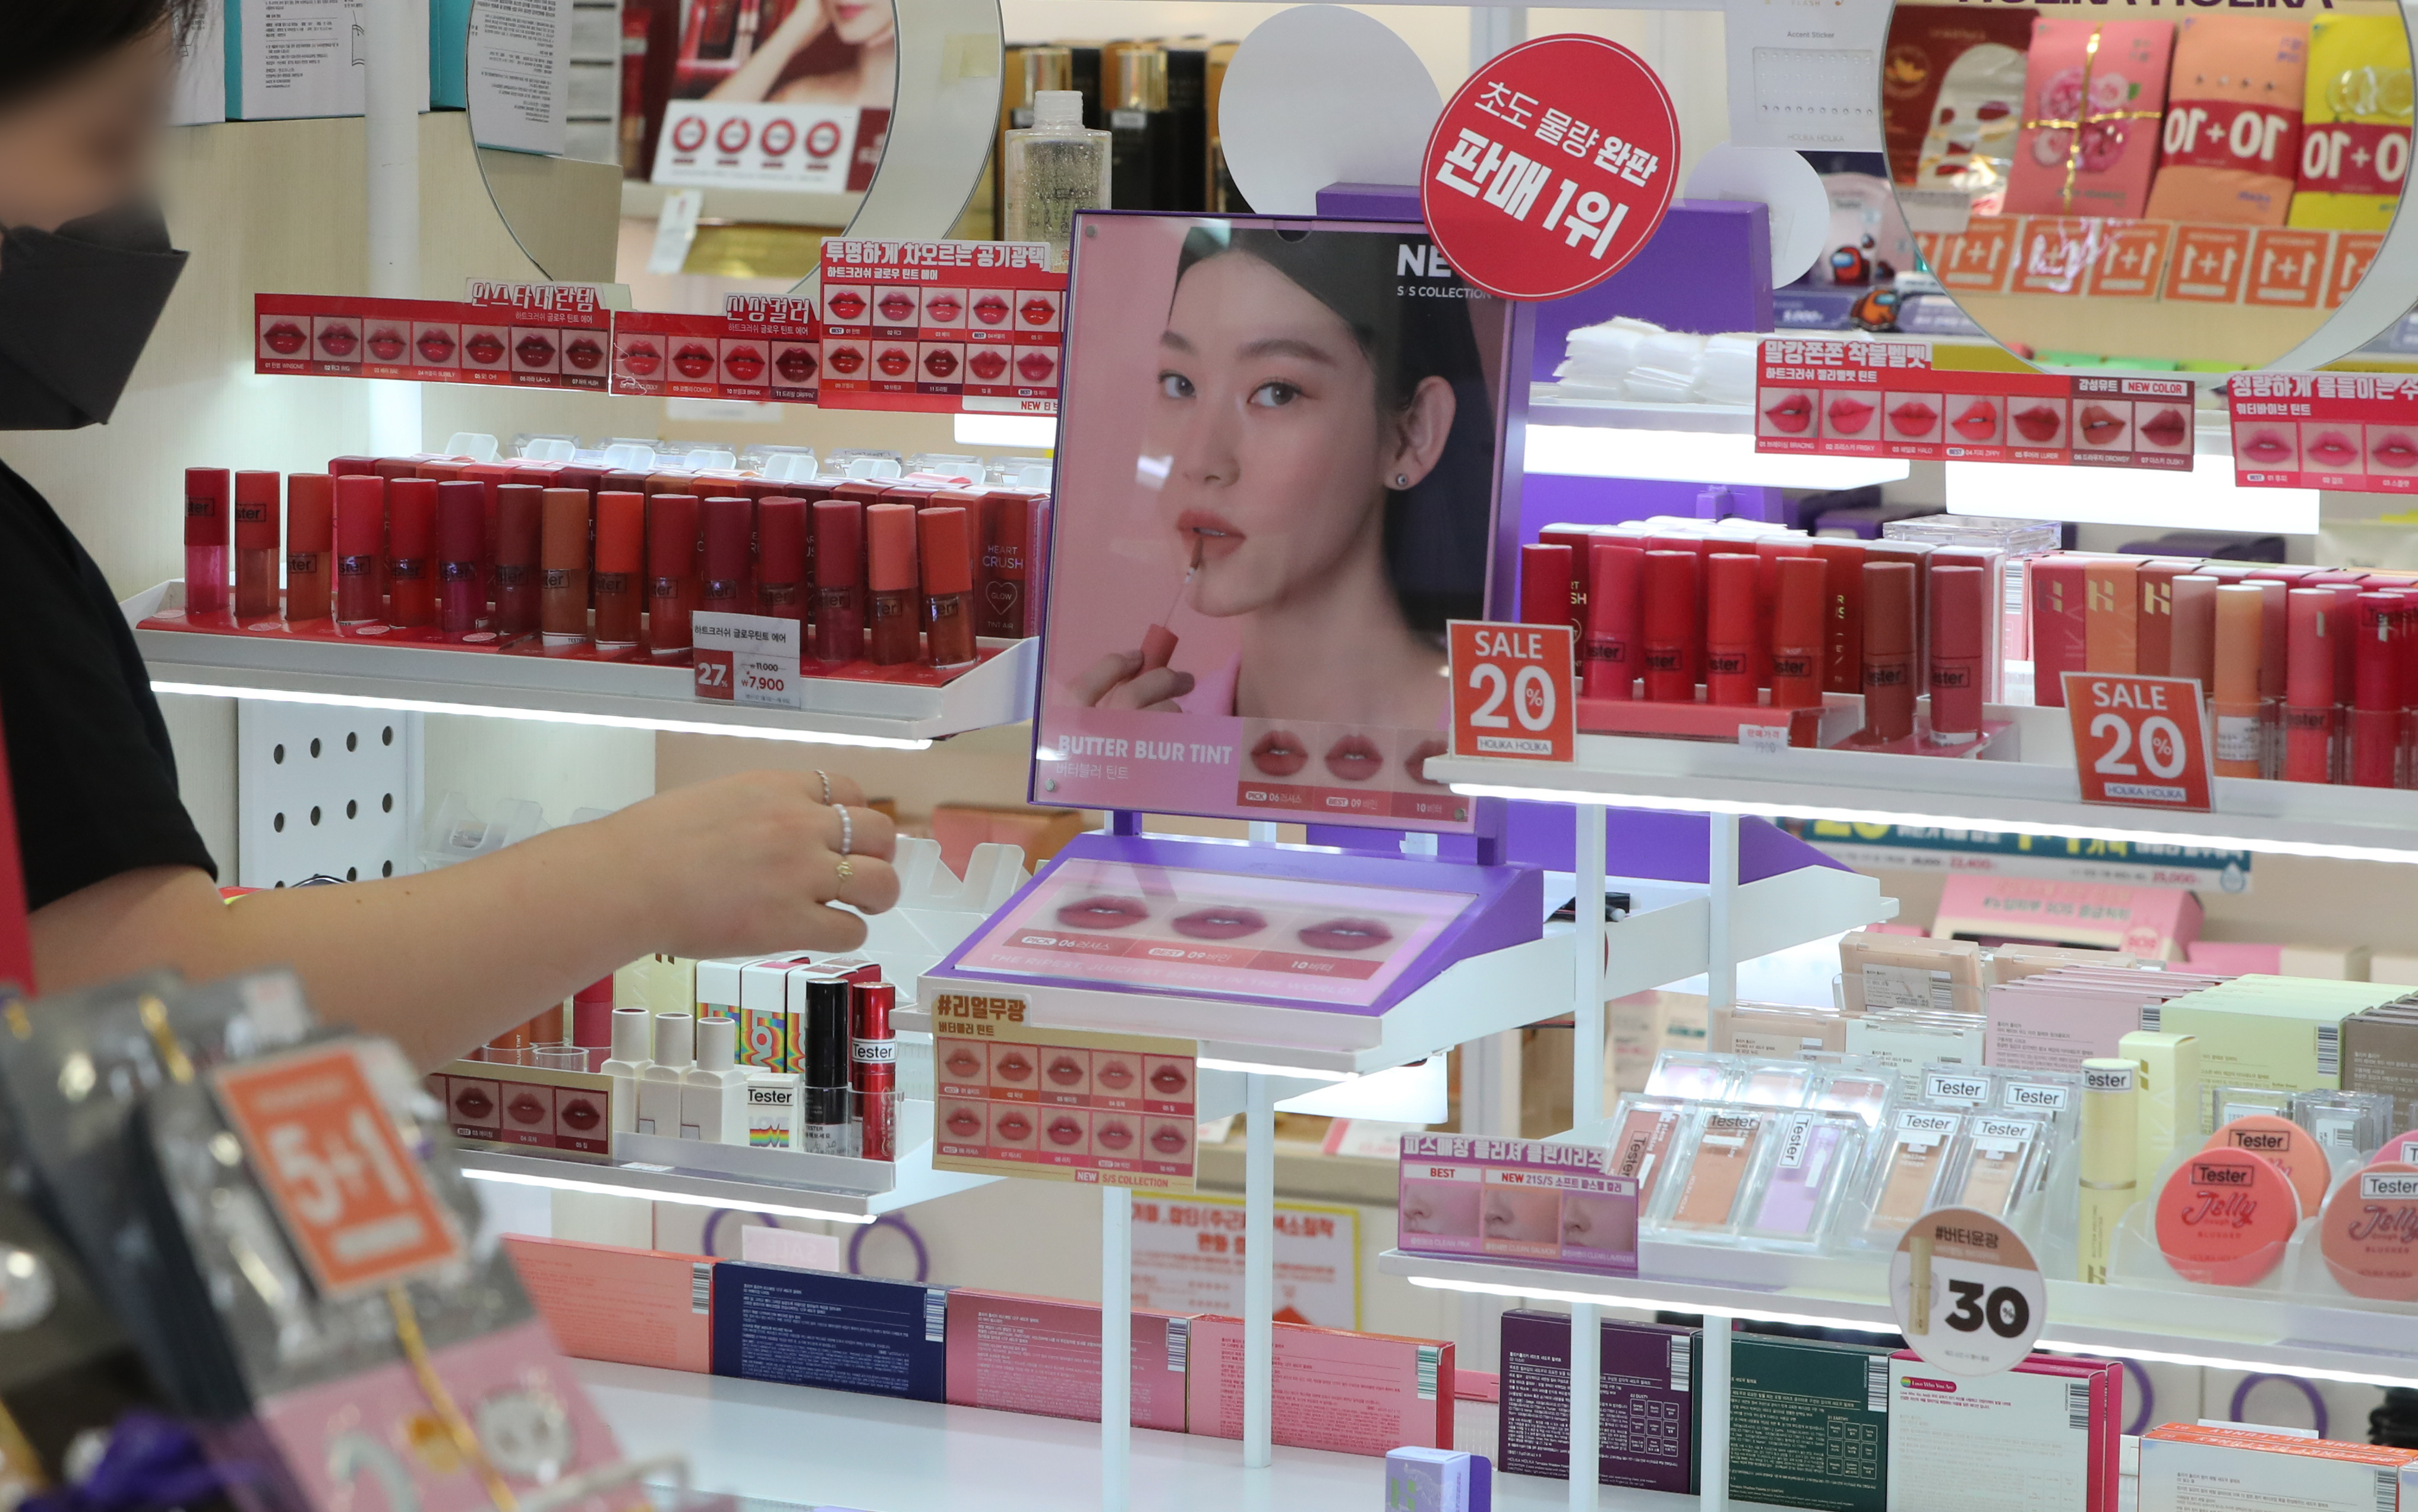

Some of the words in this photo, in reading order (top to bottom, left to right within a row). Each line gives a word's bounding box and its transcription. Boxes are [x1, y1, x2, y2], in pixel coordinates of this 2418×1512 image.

[1475, 81, 1539, 130] 초도
[1535, 108, 1600, 158] 물량
[1594, 136, 1659, 188] 완판
[1435, 128, 1552, 221] 판매
[1542, 179, 1629, 260] 1위
[826, 241, 899, 265] 투명하게
[904, 243, 973, 267] 차오르는
[977, 245, 1045, 270] 공기광택
[827, 266, 872, 279] 하트크러쉬
[873, 267, 900, 279] 글로우
[902, 269, 919, 280] 틴트
[921, 269, 938, 280] 에어
[472, 283, 595, 312] 인스타대란템
[1418, 286, 1492, 299] COLLECTION
[516, 312, 545, 321] 하트크러쉬
[547, 313, 566, 321] 글로우
[567, 314, 579, 323] 틴트
[580, 315, 593, 323] 에어
[727, 296, 810, 324] 신상컬러
[728, 323, 759, 333] 하트크러쉬
[760, 325, 779, 334] 글로우
[781, 326, 794, 334] 틴트
[796, 327, 809, 336] 에어
[1764, 340, 1844, 365] 말캉쫀쫀
[1848, 341, 1926, 369] 착붙벨벳
[1766, 367, 1815, 380] 하트크러쉬
[1817, 369, 1856, 381] 젤리벨벳
[1858, 370, 1877, 383] 틴트
[2129, 382, 2150, 392] NEW
[2152, 383, 2182, 393] COLOR
[2232, 375, 2312, 397] 청량하게
[2317, 377, 2395, 400] 물들이는
[1021, 401, 1040, 410] NEW
[2236, 403, 2288, 415] 워터바이브
[2290, 403, 2312, 416] 틴트
[235, 506, 261, 520] ster
[987, 545, 1018, 555] HEART
[287, 557, 311, 572] ster
[982, 555, 1024, 569] CRUSH
[991, 592, 1012, 601] GLOW
[694, 625, 731, 637] 하트크러쉬
[733, 629, 769, 642] 글로우틴트
[772, 632, 786, 643] 에어
[1475, 631, 1542, 659] SALE
[1587, 643, 1620, 659] ster
[1709, 656, 1740, 671] ster
[1774, 659, 1807, 674] ster
[697, 662, 728, 688] 27%
[1931, 671, 1965, 684] ster
[2092, 681, 2168, 712] SALE
[1059, 735, 1128, 757] BUTTER
[1135, 740, 1184, 762] BLUR
[1190, 744, 1233, 765] TINT
[1480, 740, 1513, 750] HOLIKA
[1516, 741, 1548, 752] HOLIKA
[1056, 762, 1101, 778] 버터블러
[1107, 766, 1128, 779] 틴트
[1269, 793, 1280, 801] 06
[2107, 784, 2145, 796] HOLIKA
[2146, 787, 2184, 799] HOLIKA
[1351, 799, 1362, 807] 09
[1416, 803, 1426, 812] 10
[990, 954, 1022, 963] THE
[1292, 961, 1308, 969] 10
[937, 994, 1026, 1022] #리얼무광
[939, 1021, 974, 1034] 버터블러
[977, 1024, 995, 1036] 틴트
[853, 1042, 892, 1058] Tester
[1935, 1079, 1981, 1096] Tester
[2083, 1072, 2127, 1087] Tester
[748, 1089, 792, 1104] Tester
[2013, 1088, 2060, 1106] Tester
[1710, 1114, 1756, 1128] Tester
[1905, 1115, 1952, 1130] Tester
[1981, 1122, 2028, 1138] Tester
[1785, 1118, 1809, 1161] Tester
[2236, 1133, 2283, 1149] Tester
[1403, 1135, 1469, 1159] 피스매칭
[1473, 1139, 1521, 1161] 블러셔
[1527, 1143, 1603, 1167] 클린시리즈
[1622, 1137, 1646, 1178] Tester
[267, 1108, 416, 1227] 5+1
[1430, 1167, 1456, 1178] BEST
[2199, 1167, 2246, 1184] Tester
[1078, 1171, 1097, 1182] NEW
[1102, 1174, 1117, 1185] S/S
[1118, 1175, 1169, 1188] COLLECTION
[1502, 1173, 1524, 1183] NEW
[1526, 1175, 1553, 1186] 21S/S
[1555, 1177, 1579, 1188] 소프트
[1582, 1178, 1604, 1191] 파스텔
[1606, 1182, 1621, 1193] 컬러
[2370, 1179, 2418, 1194] Tester
[2181, 1191, 2258, 1227] Jelly
[1935, 1224, 1999, 1248] #버터윤광
